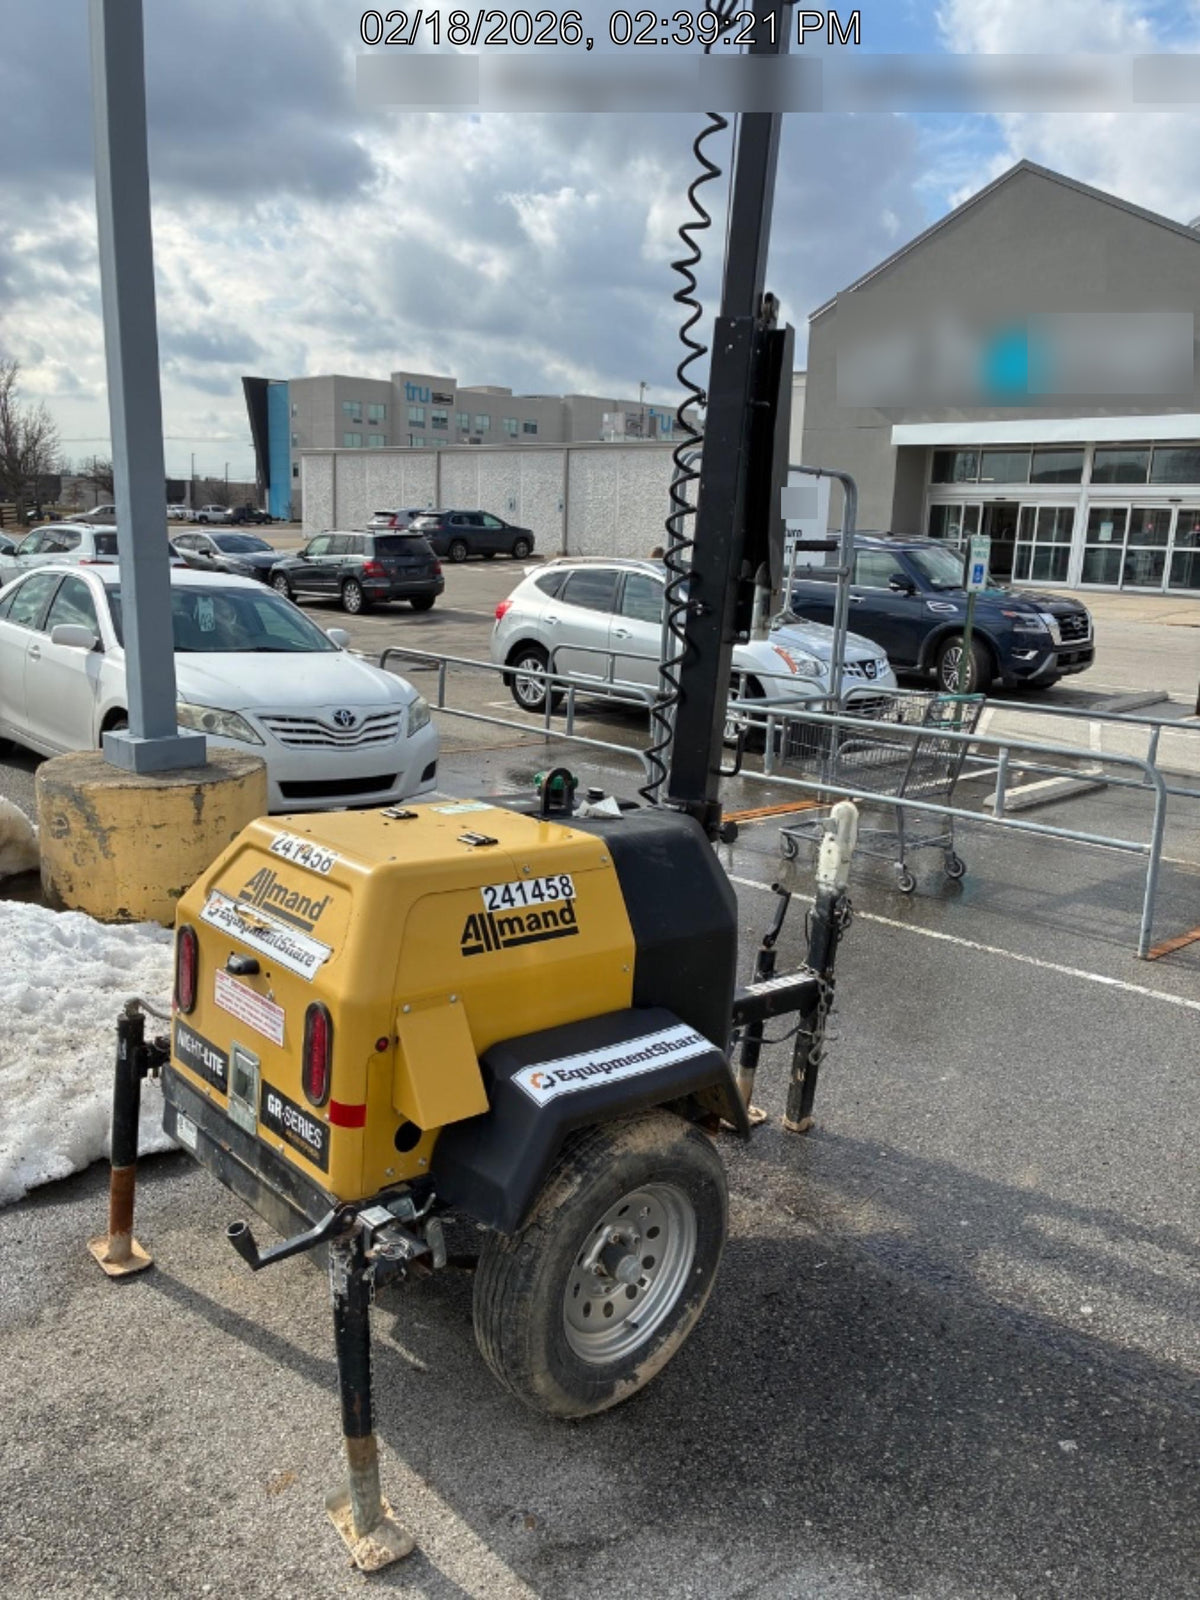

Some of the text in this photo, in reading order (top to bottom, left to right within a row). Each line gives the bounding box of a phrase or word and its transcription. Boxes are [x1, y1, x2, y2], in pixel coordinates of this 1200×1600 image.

[404, 381, 430, 403] tru
[244, 867, 330, 922] Allmand
[484, 875, 573, 911] 241458
[461, 898, 577, 952] Allmand
[267, 1093, 322, 1149] GR-SERIES
